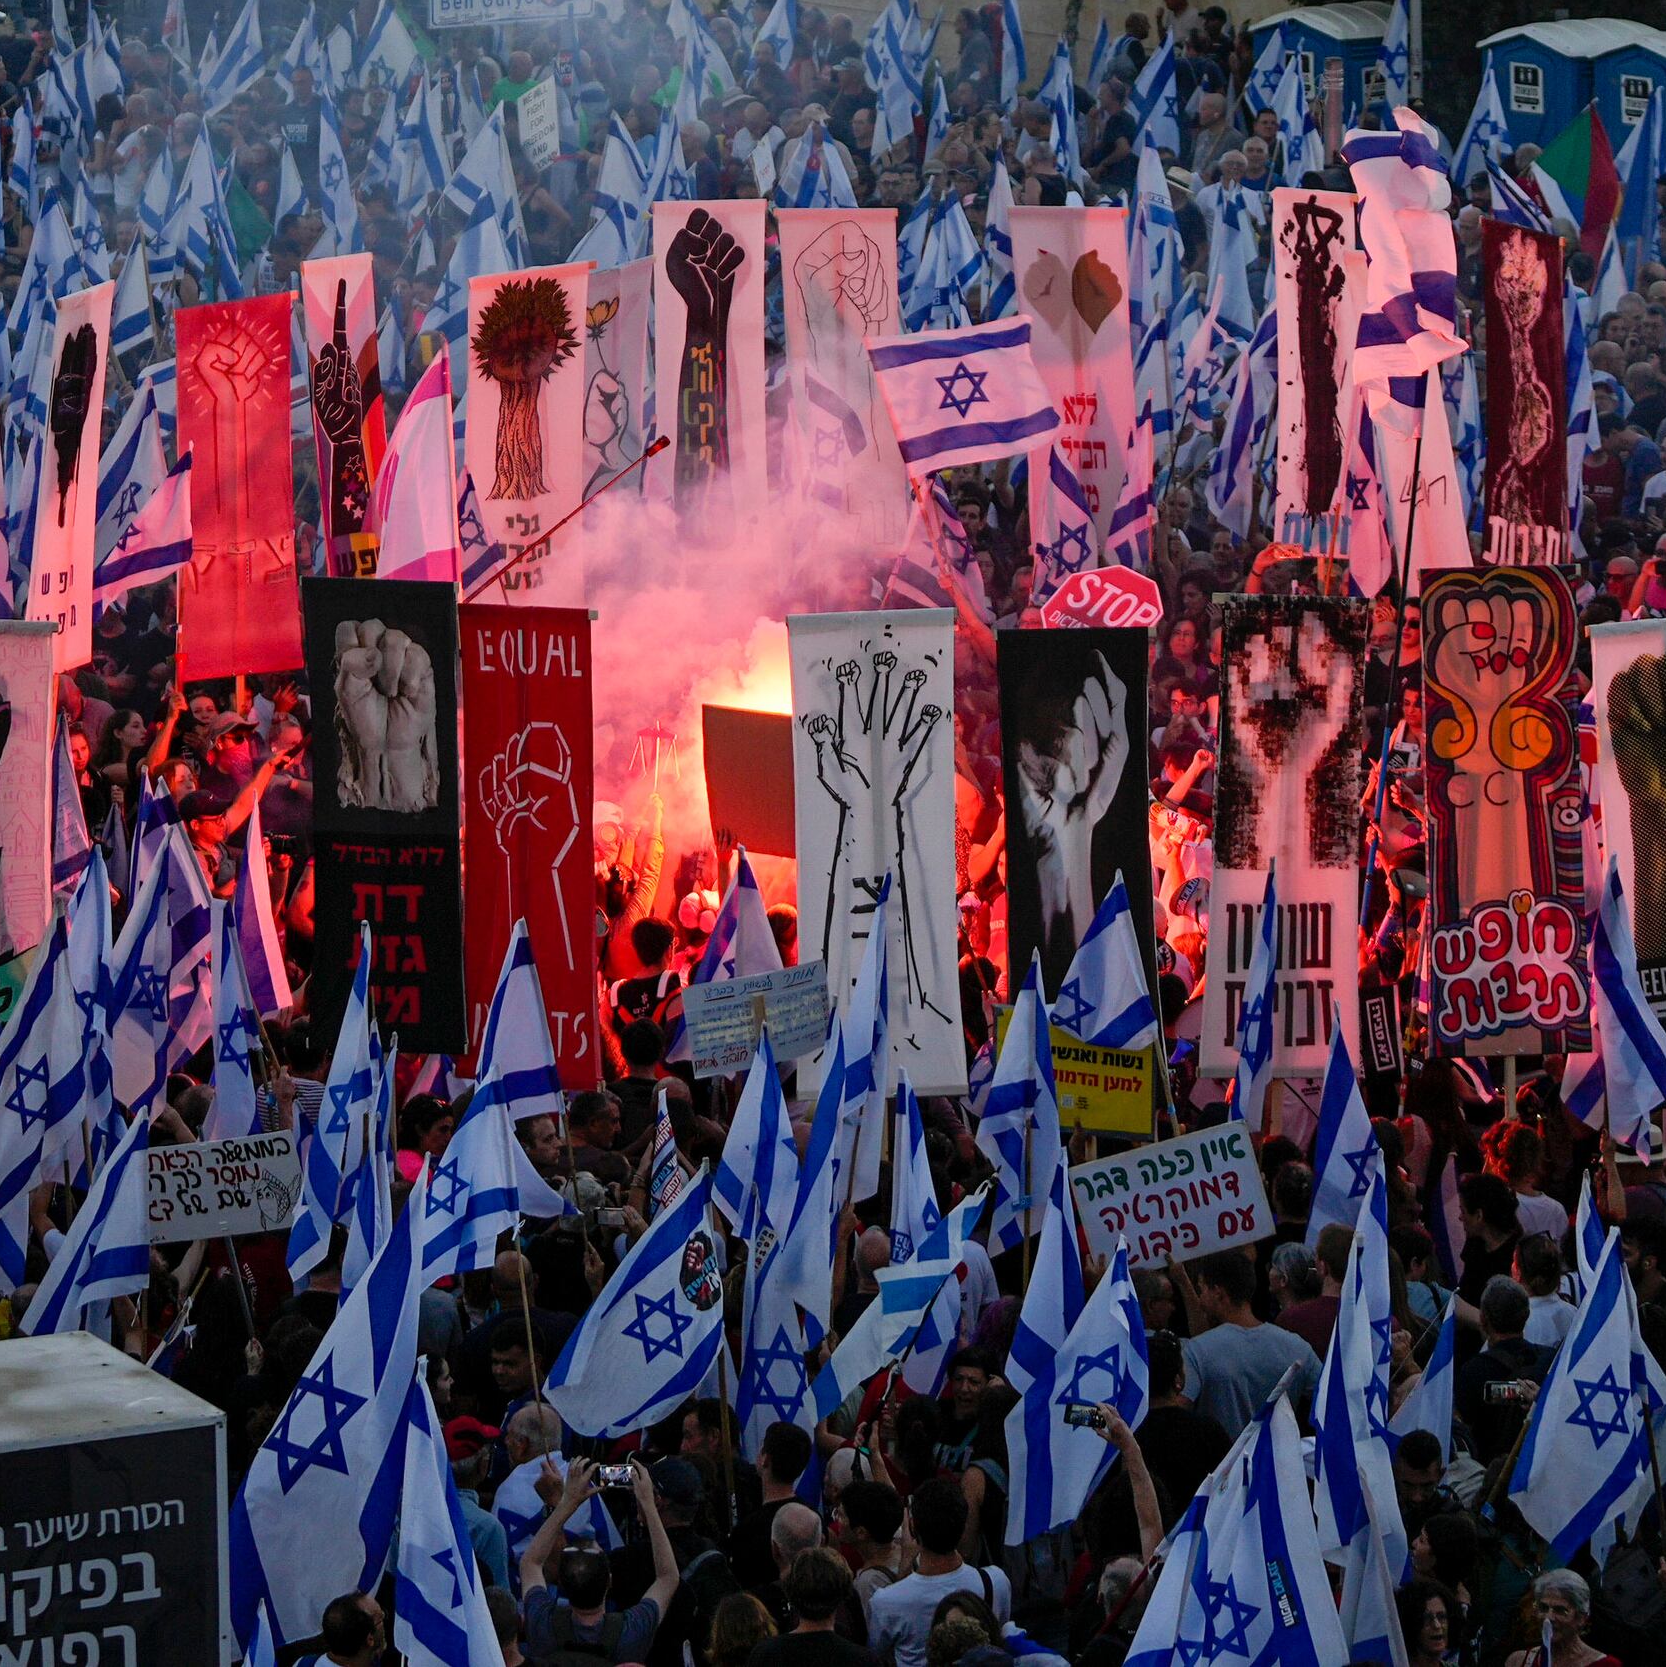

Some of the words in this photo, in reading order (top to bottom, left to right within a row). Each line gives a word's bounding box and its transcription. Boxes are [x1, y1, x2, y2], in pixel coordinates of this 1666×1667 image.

[527, 99, 547, 118] FIGHT
[530, 114, 544, 130] FOR
[1063, 391, 1098, 425] ללא
[1066, 573, 1159, 627] STOP
[477, 628, 583, 678] EQUAL
[352, 882, 426, 923] דת
[1226, 902, 1326, 974] שווון
[1432, 889, 1573, 975] חופש
[369, 984, 423, 1024] מי
[1223, 979, 1334, 1048] זכוית
[1440, 958, 1584, 1034] תרבות
[1101, 1052, 1144, 1071] נשות
[1103, 1072, 1143, 1093] למען
[1138, 1149, 1195, 1185] כזה
[1200, 1133, 1246, 1176] אין
[1074, 1166, 1130, 1201] דבר
[1099, 1171, 1240, 1232] דמוקרטיה
[1218, 1205, 1255, 1235] עם
[1127, 1222, 1201, 1265] כיבו
[13, 1509, 90, 1546] שיער
[100, 1497, 186, 1536] הסרת
